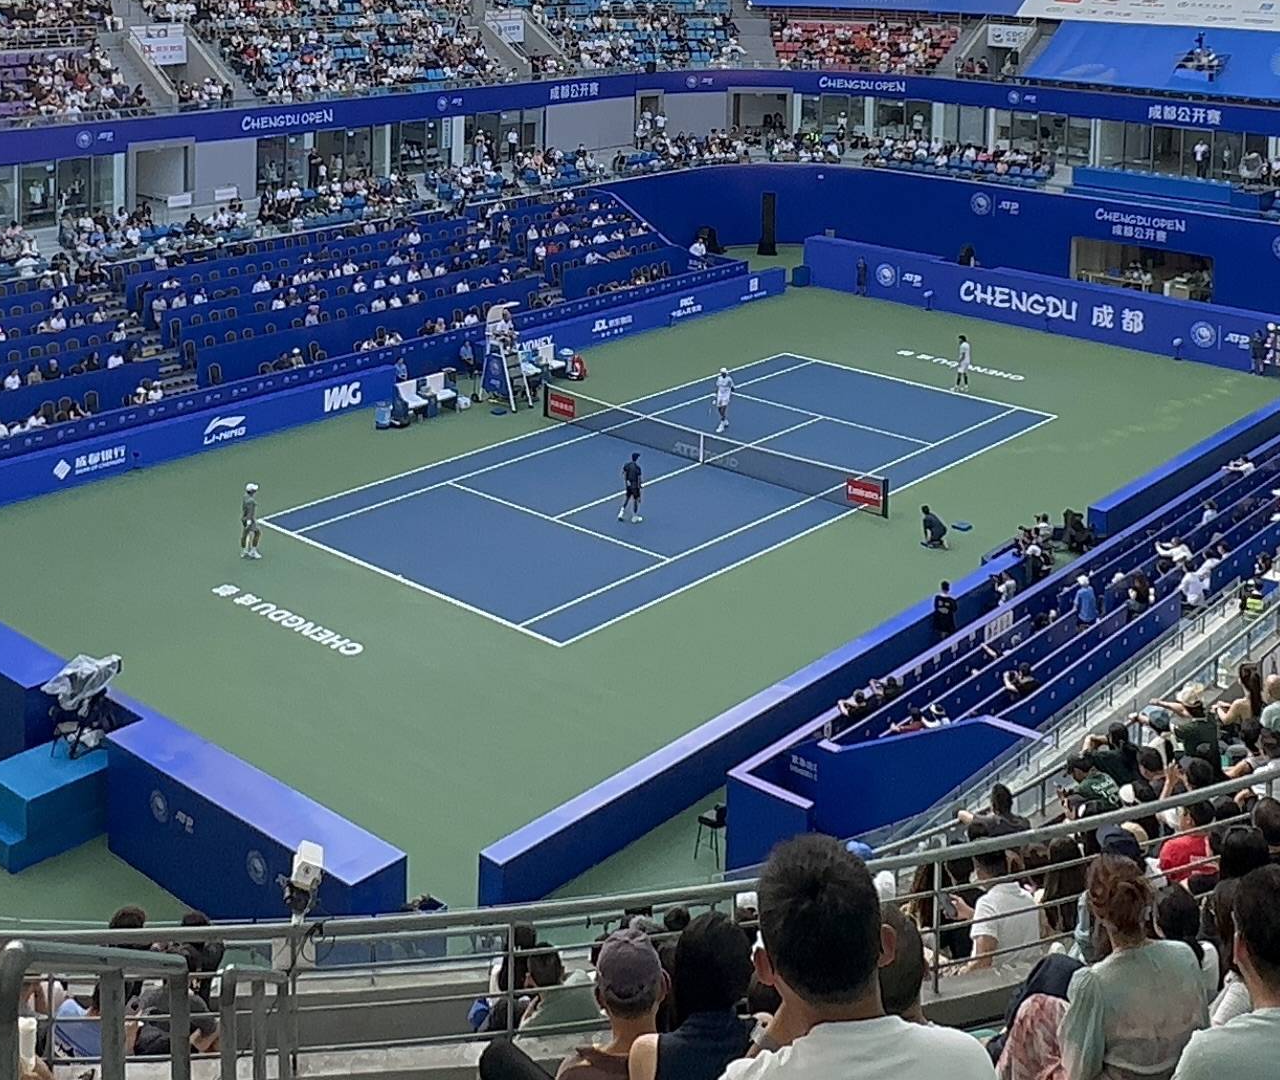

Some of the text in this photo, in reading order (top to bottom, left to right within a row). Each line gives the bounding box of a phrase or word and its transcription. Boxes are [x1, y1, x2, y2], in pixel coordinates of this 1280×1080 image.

[550, 82, 600, 101] 成都公开赛
[819, 75, 906, 93] CHENGDU OPEN
[241, 108, 334, 131] CHENGDU OPEN
[1147, 104, 1222, 126] 成都公开赛
[1095, 207, 1186, 232] CHENGDU OPEN
[1111, 225, 1167, 243] 成都公开赛
[959, 280, 1144, 333] CHENGDU 成都
[1224, 332, 1250, 344] ATP
[203, 426, 246, 445] LI-NING
[251, 602, 364, 656] CHENGDU
